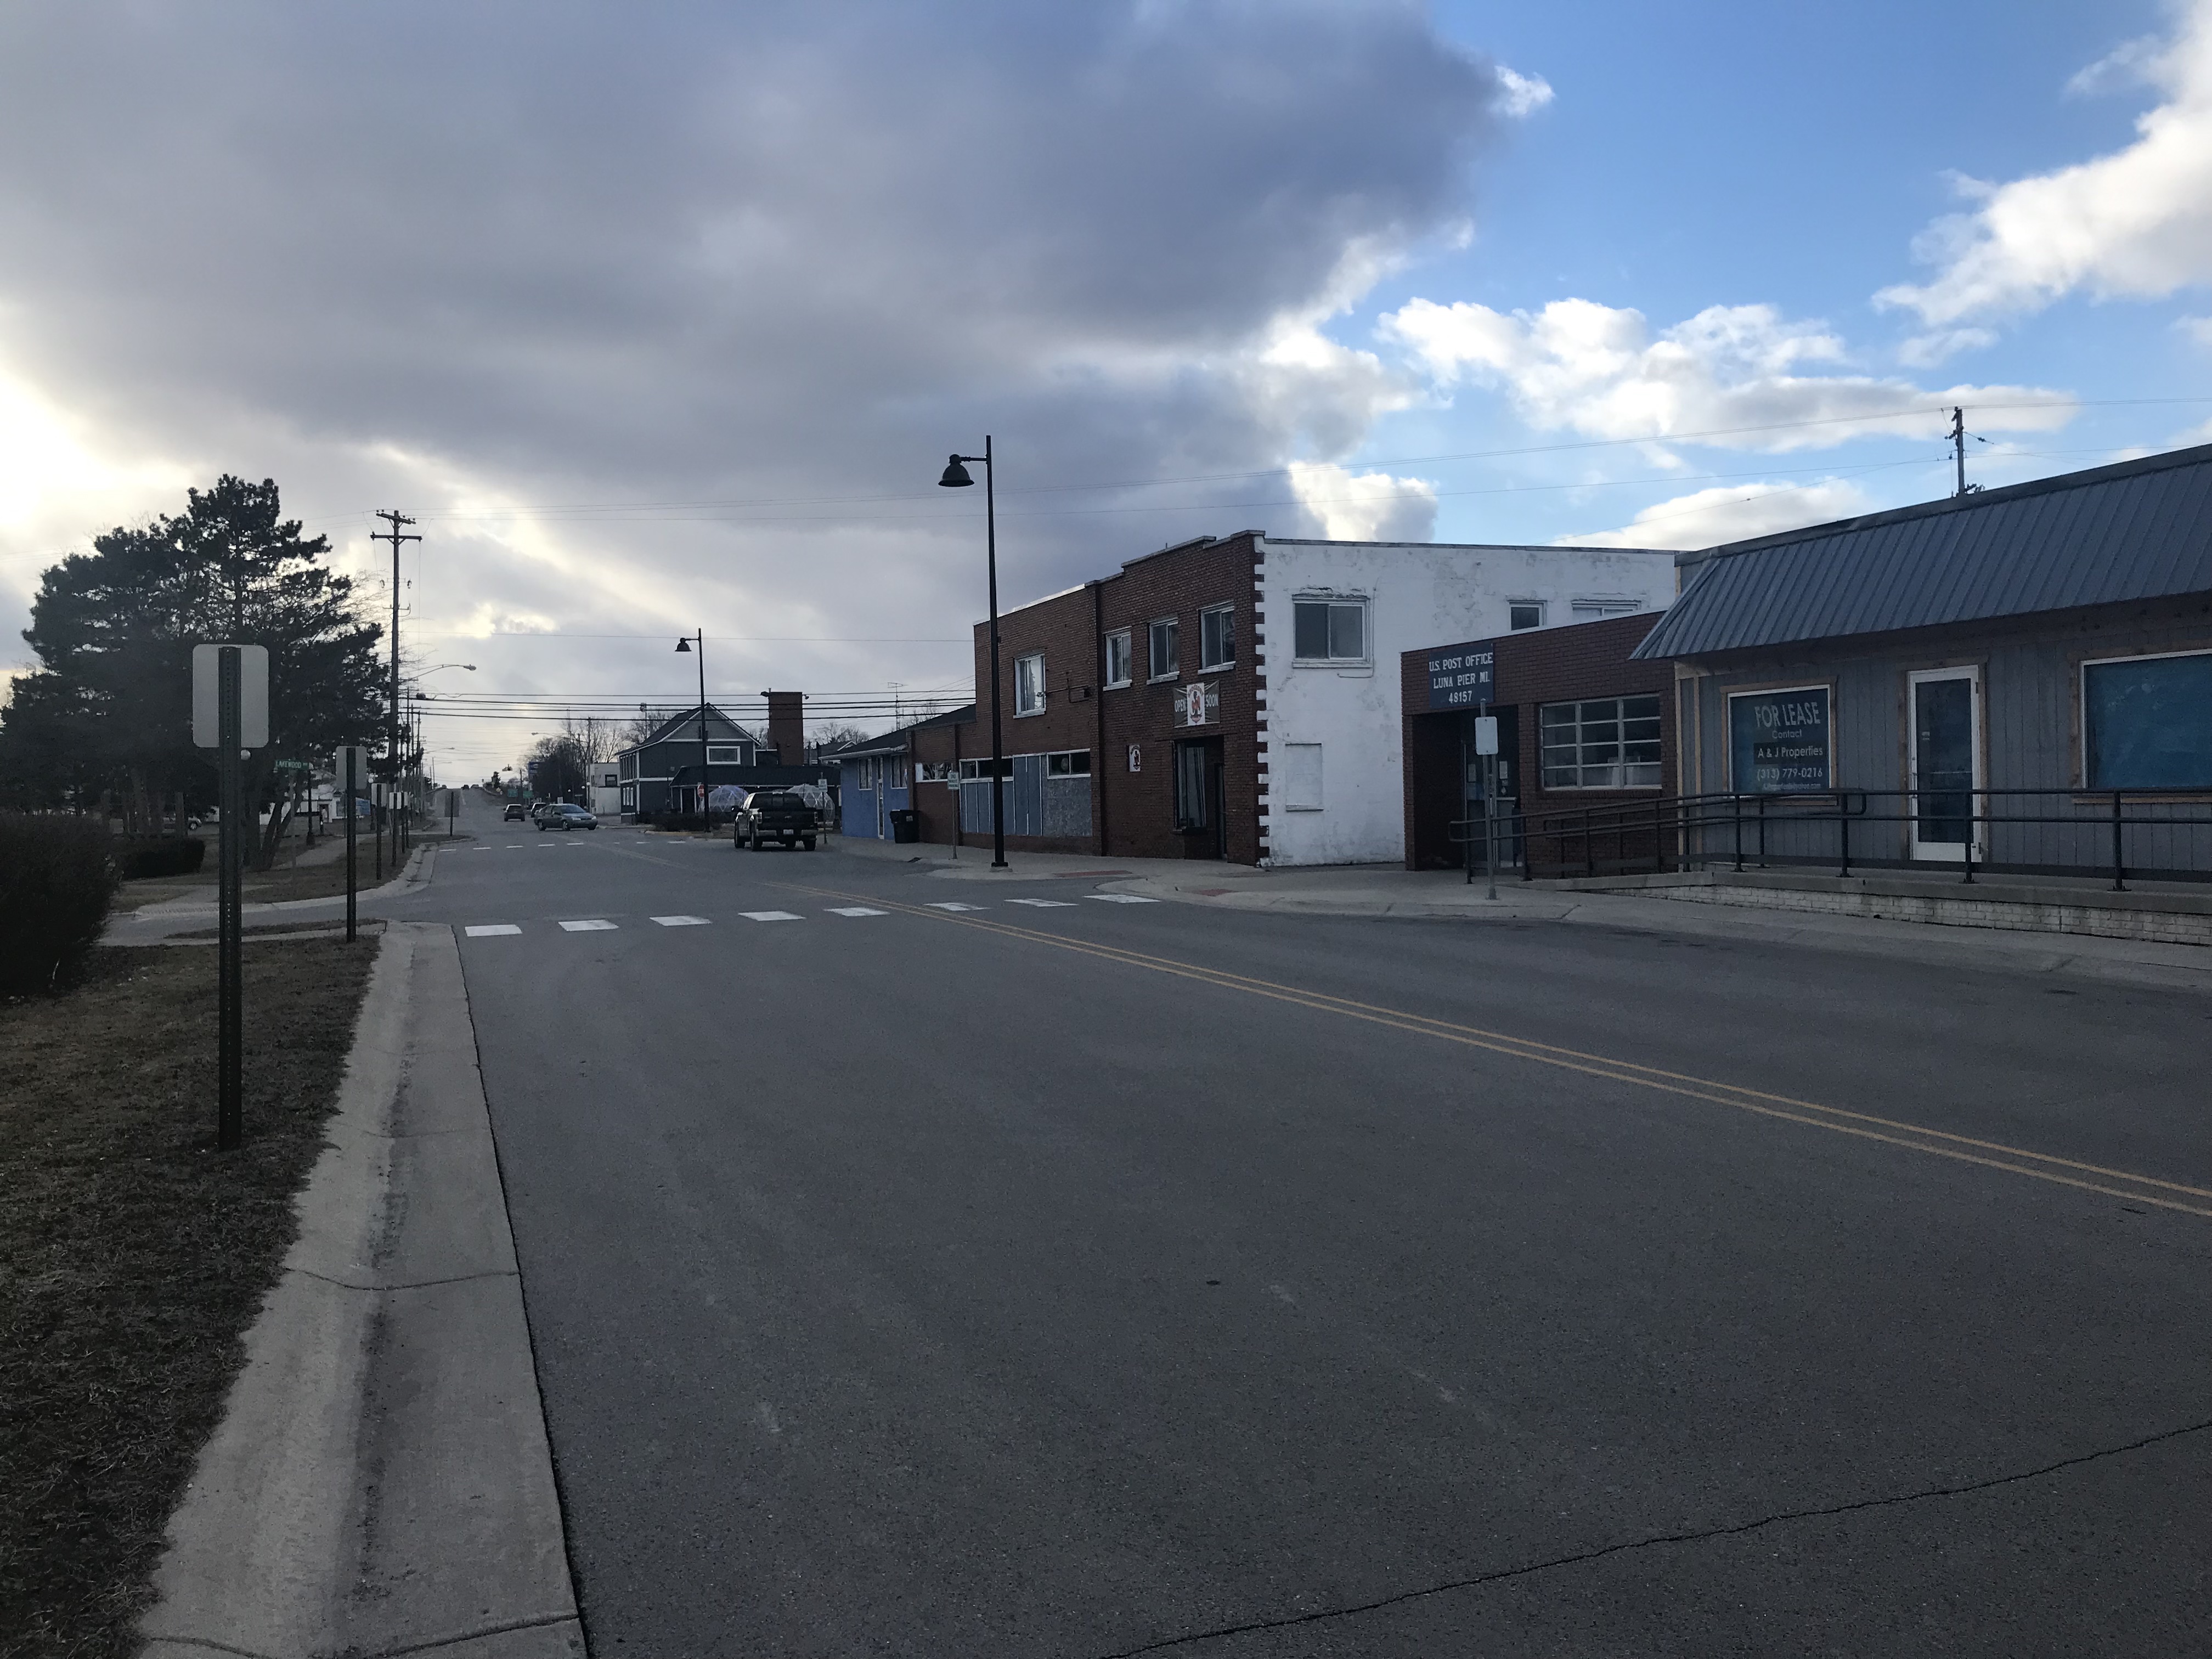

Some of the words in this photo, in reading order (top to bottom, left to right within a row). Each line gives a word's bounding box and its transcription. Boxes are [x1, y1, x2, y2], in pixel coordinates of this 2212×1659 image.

[1442, 657, 1462, 670] POST
[1465, 652, 1493, 667] OFFICE
[1433, 676, 1453, 689] LUNA
[1457, 673, 1476, 686] PIER
[1175, 698, 1187, 713] OPEN
[1205, 693, 1218, 707] SOON
[1448, 690, 1472, 704] 48157
[1754, 705, 1781, 727] FOR
[1782, 702, 1821, 726] LEASE
[1772, 729, 1802, 739] Contact
[1758, 748, 1764, 758] A
[1767, 748, 1773, 758] &
[1775, 747, 1779, 757] J
[1781, 745, 1823, 759] Properties
[1757, 768, 1780, 781] (313)
[1782, 768, 1822, 778] 779-0216
